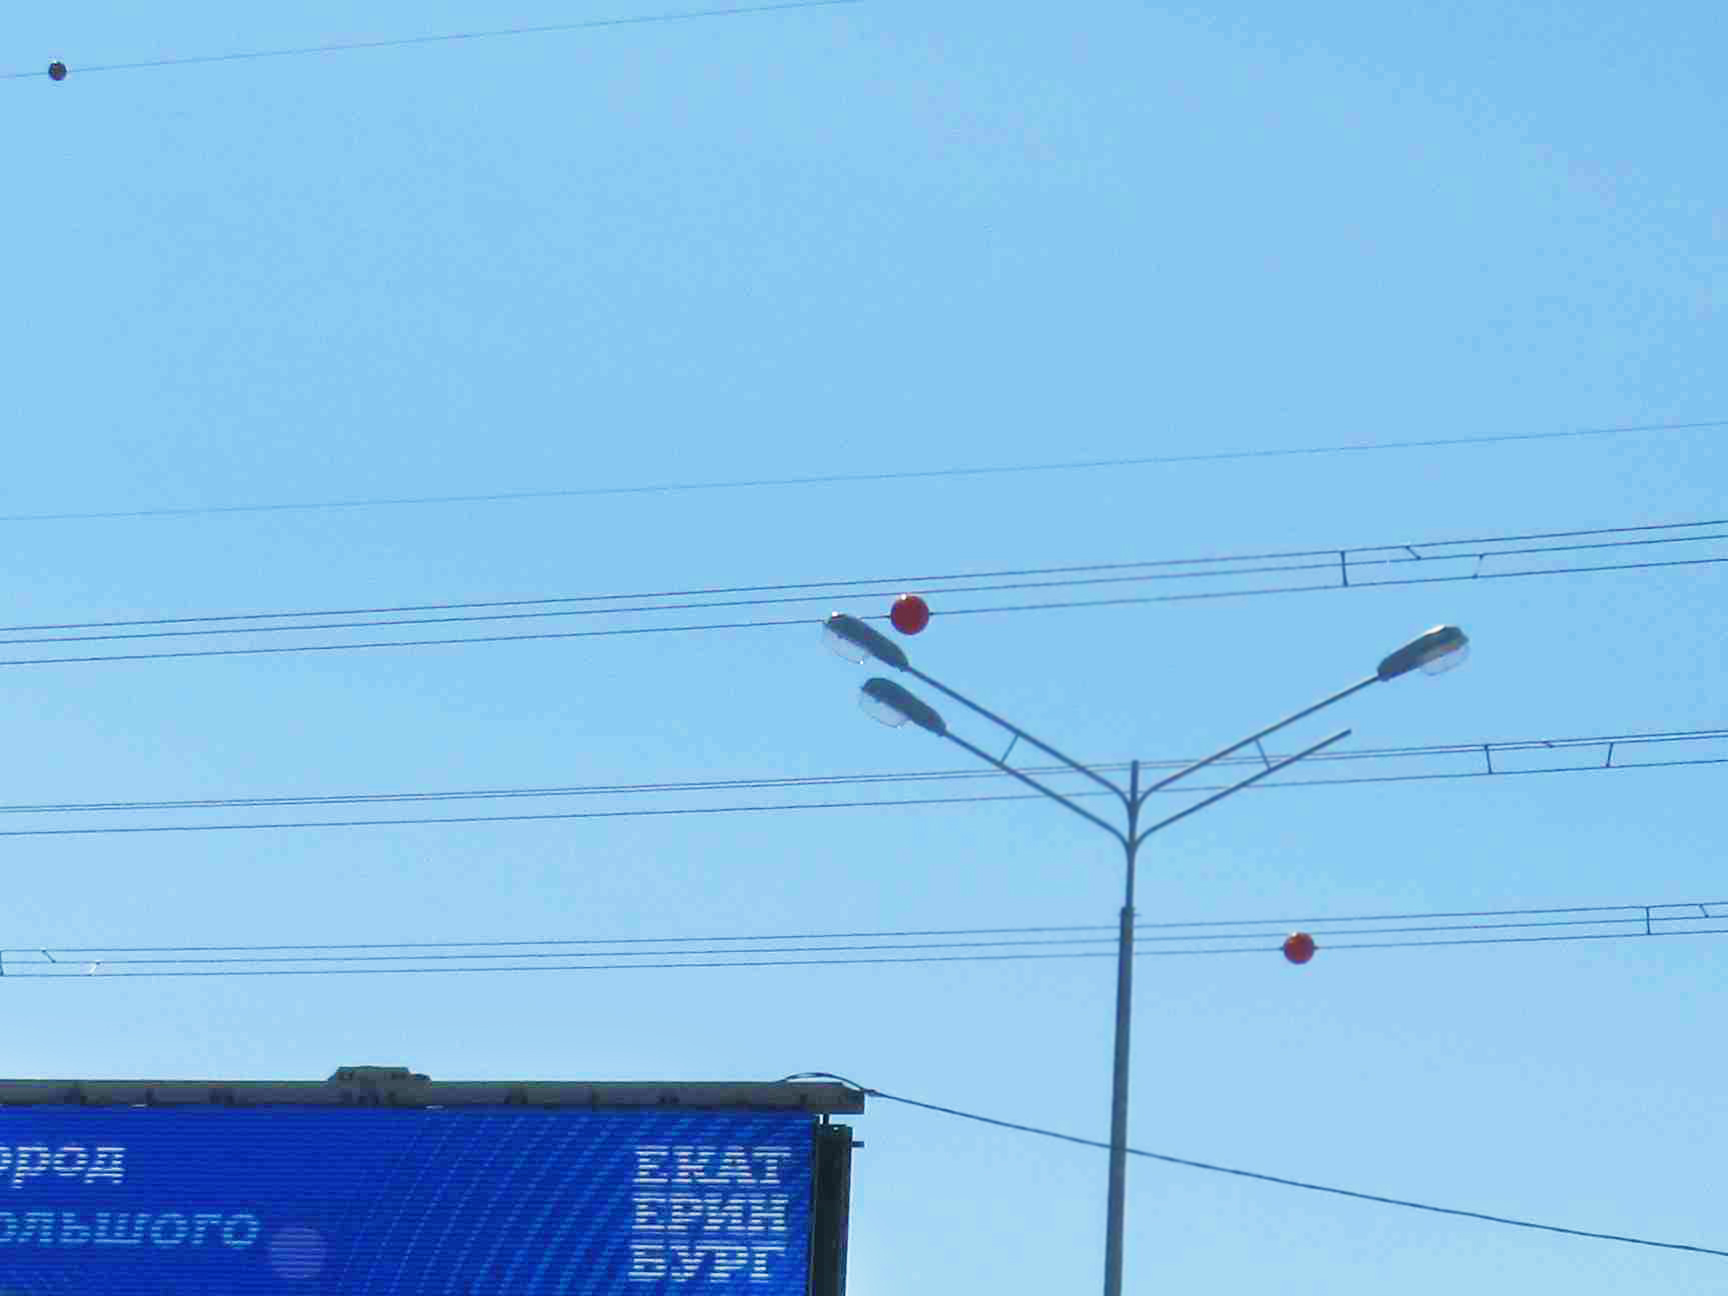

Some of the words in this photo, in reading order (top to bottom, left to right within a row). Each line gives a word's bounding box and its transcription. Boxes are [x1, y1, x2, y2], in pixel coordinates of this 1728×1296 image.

[632, 1145, 792, 1184] ЕКАТ
[631, 1192, 789, 1232] ЕРИН
[628, 1240, 786, 1283] БУРГ
